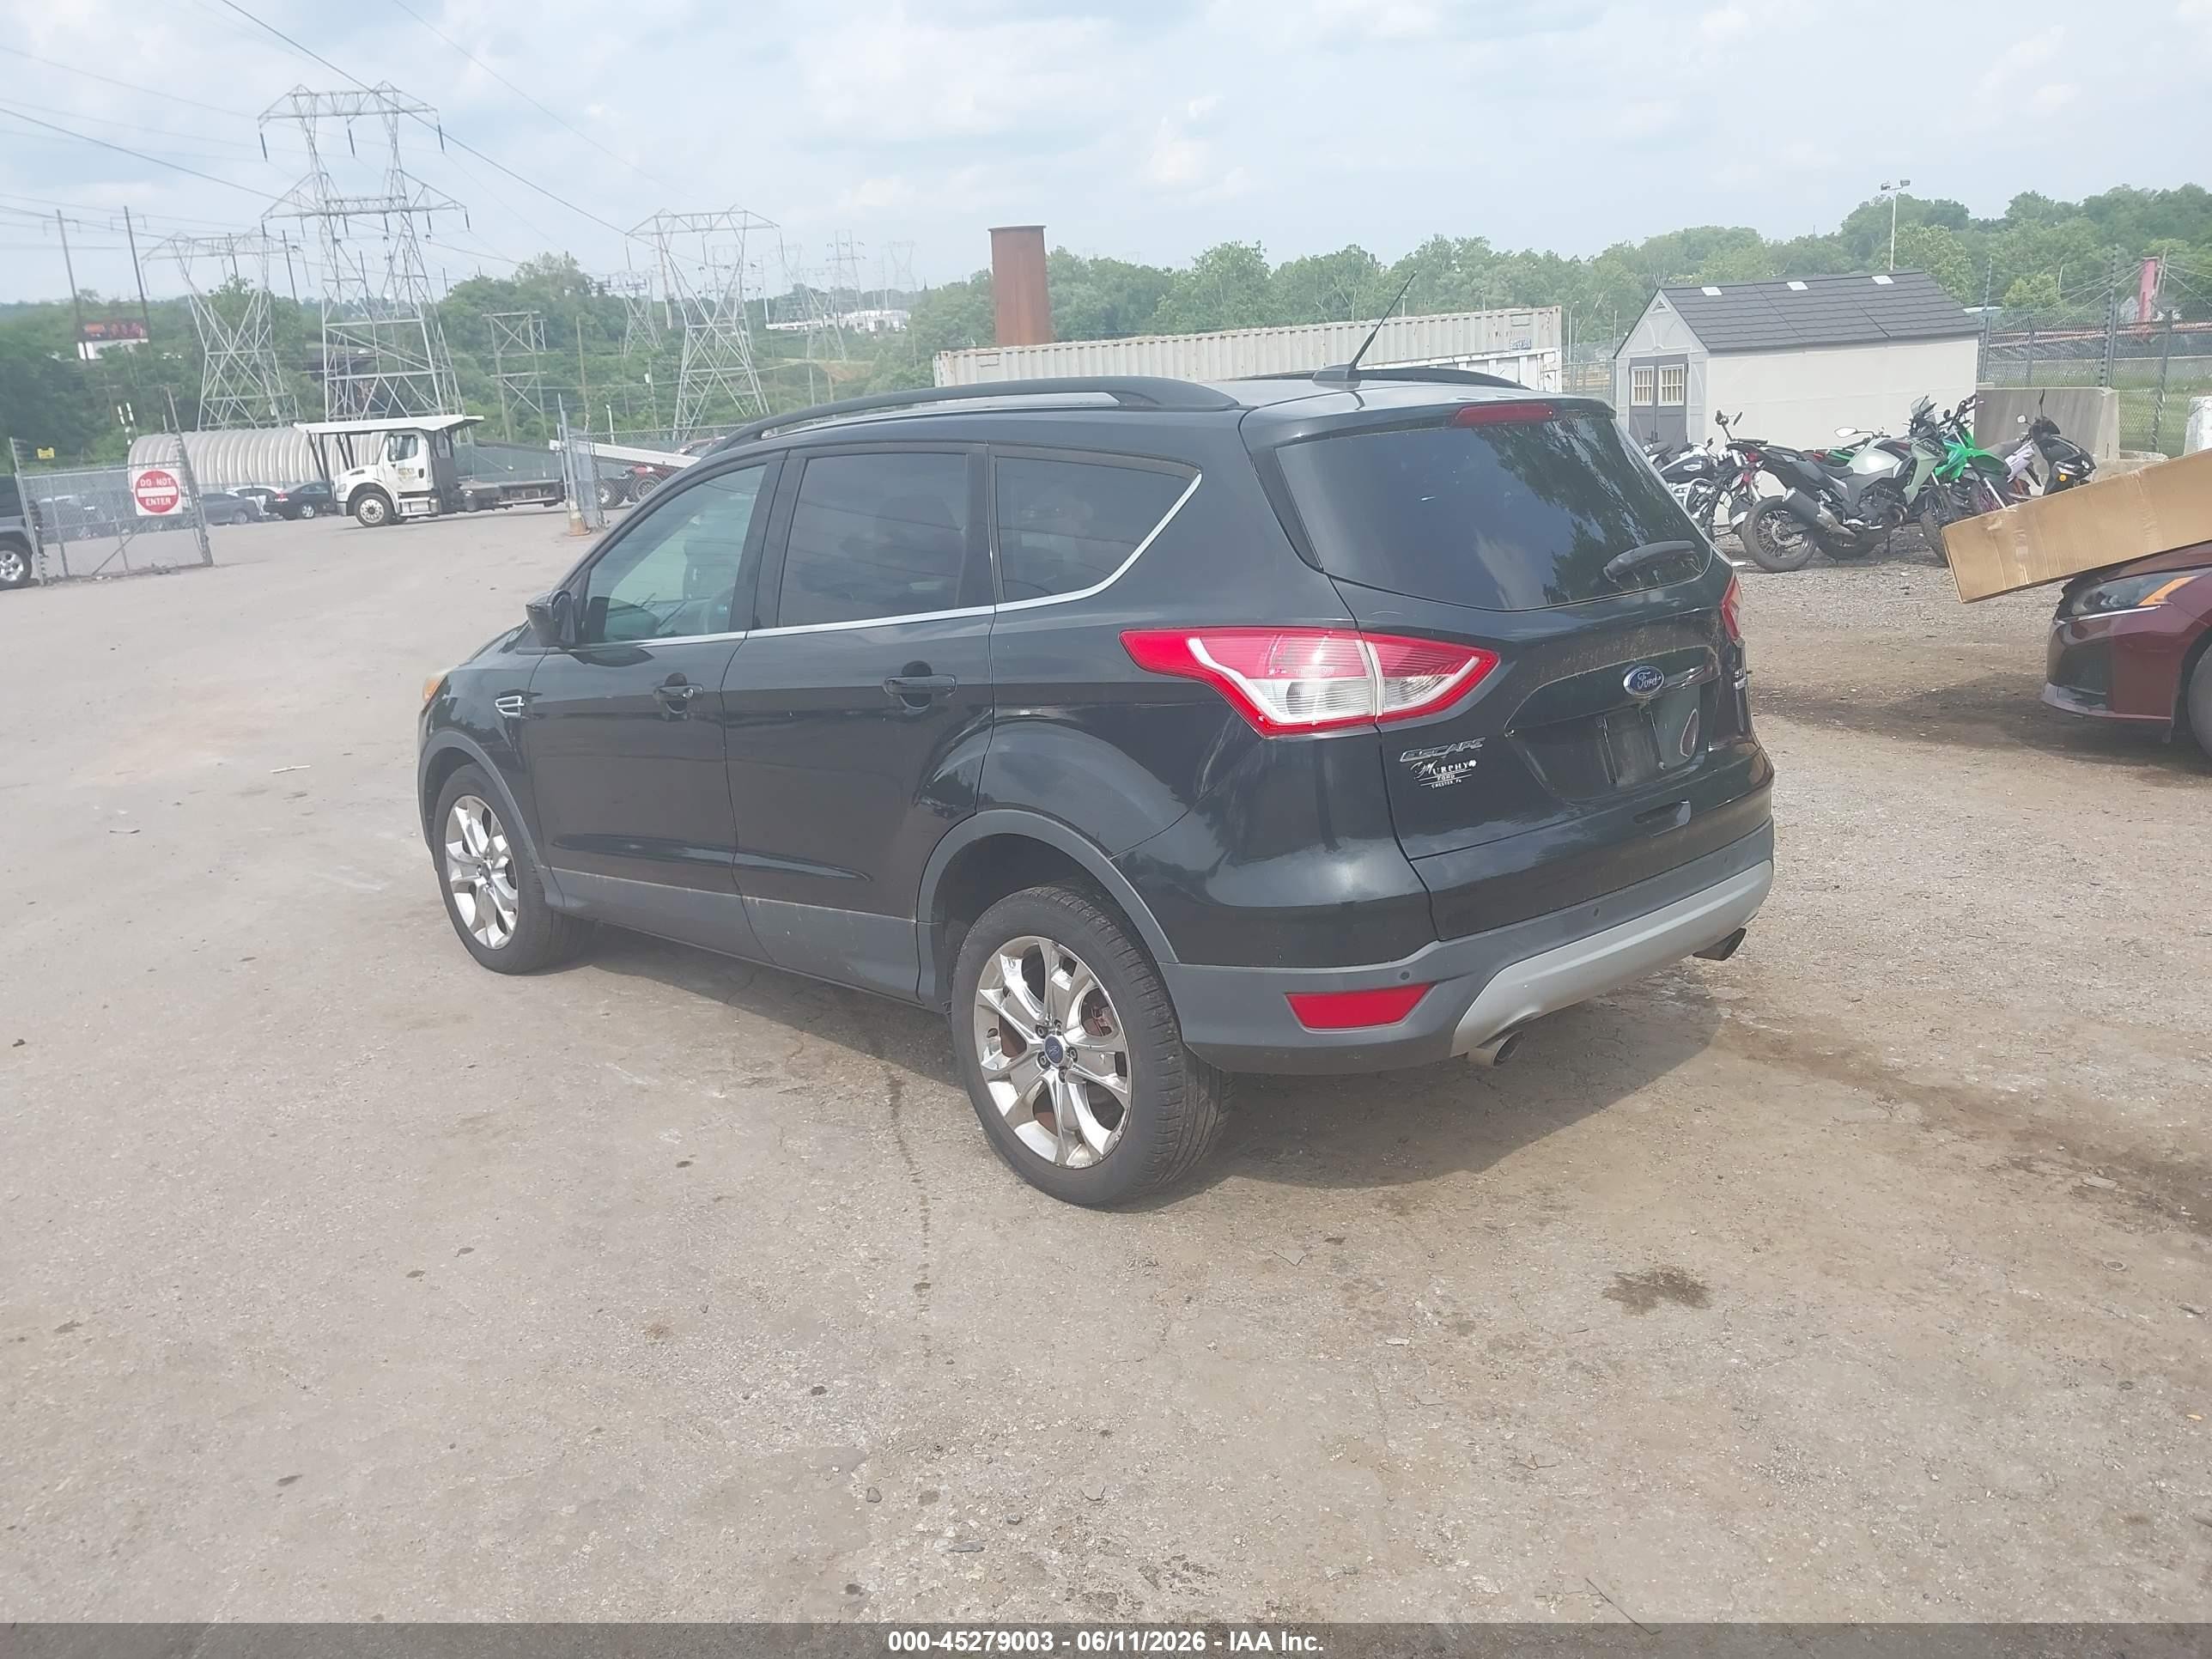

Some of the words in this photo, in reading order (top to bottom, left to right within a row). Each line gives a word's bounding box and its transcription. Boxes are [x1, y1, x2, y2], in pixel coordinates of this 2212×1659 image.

[140, 478, 152, 487] DO
[156, 477, 172, 486] NOT
[145, 496, 171, 507] ENTER
[1638, 672, 1661, 689] Ford
[1400, 737, 1486, 763] ESCAPE
